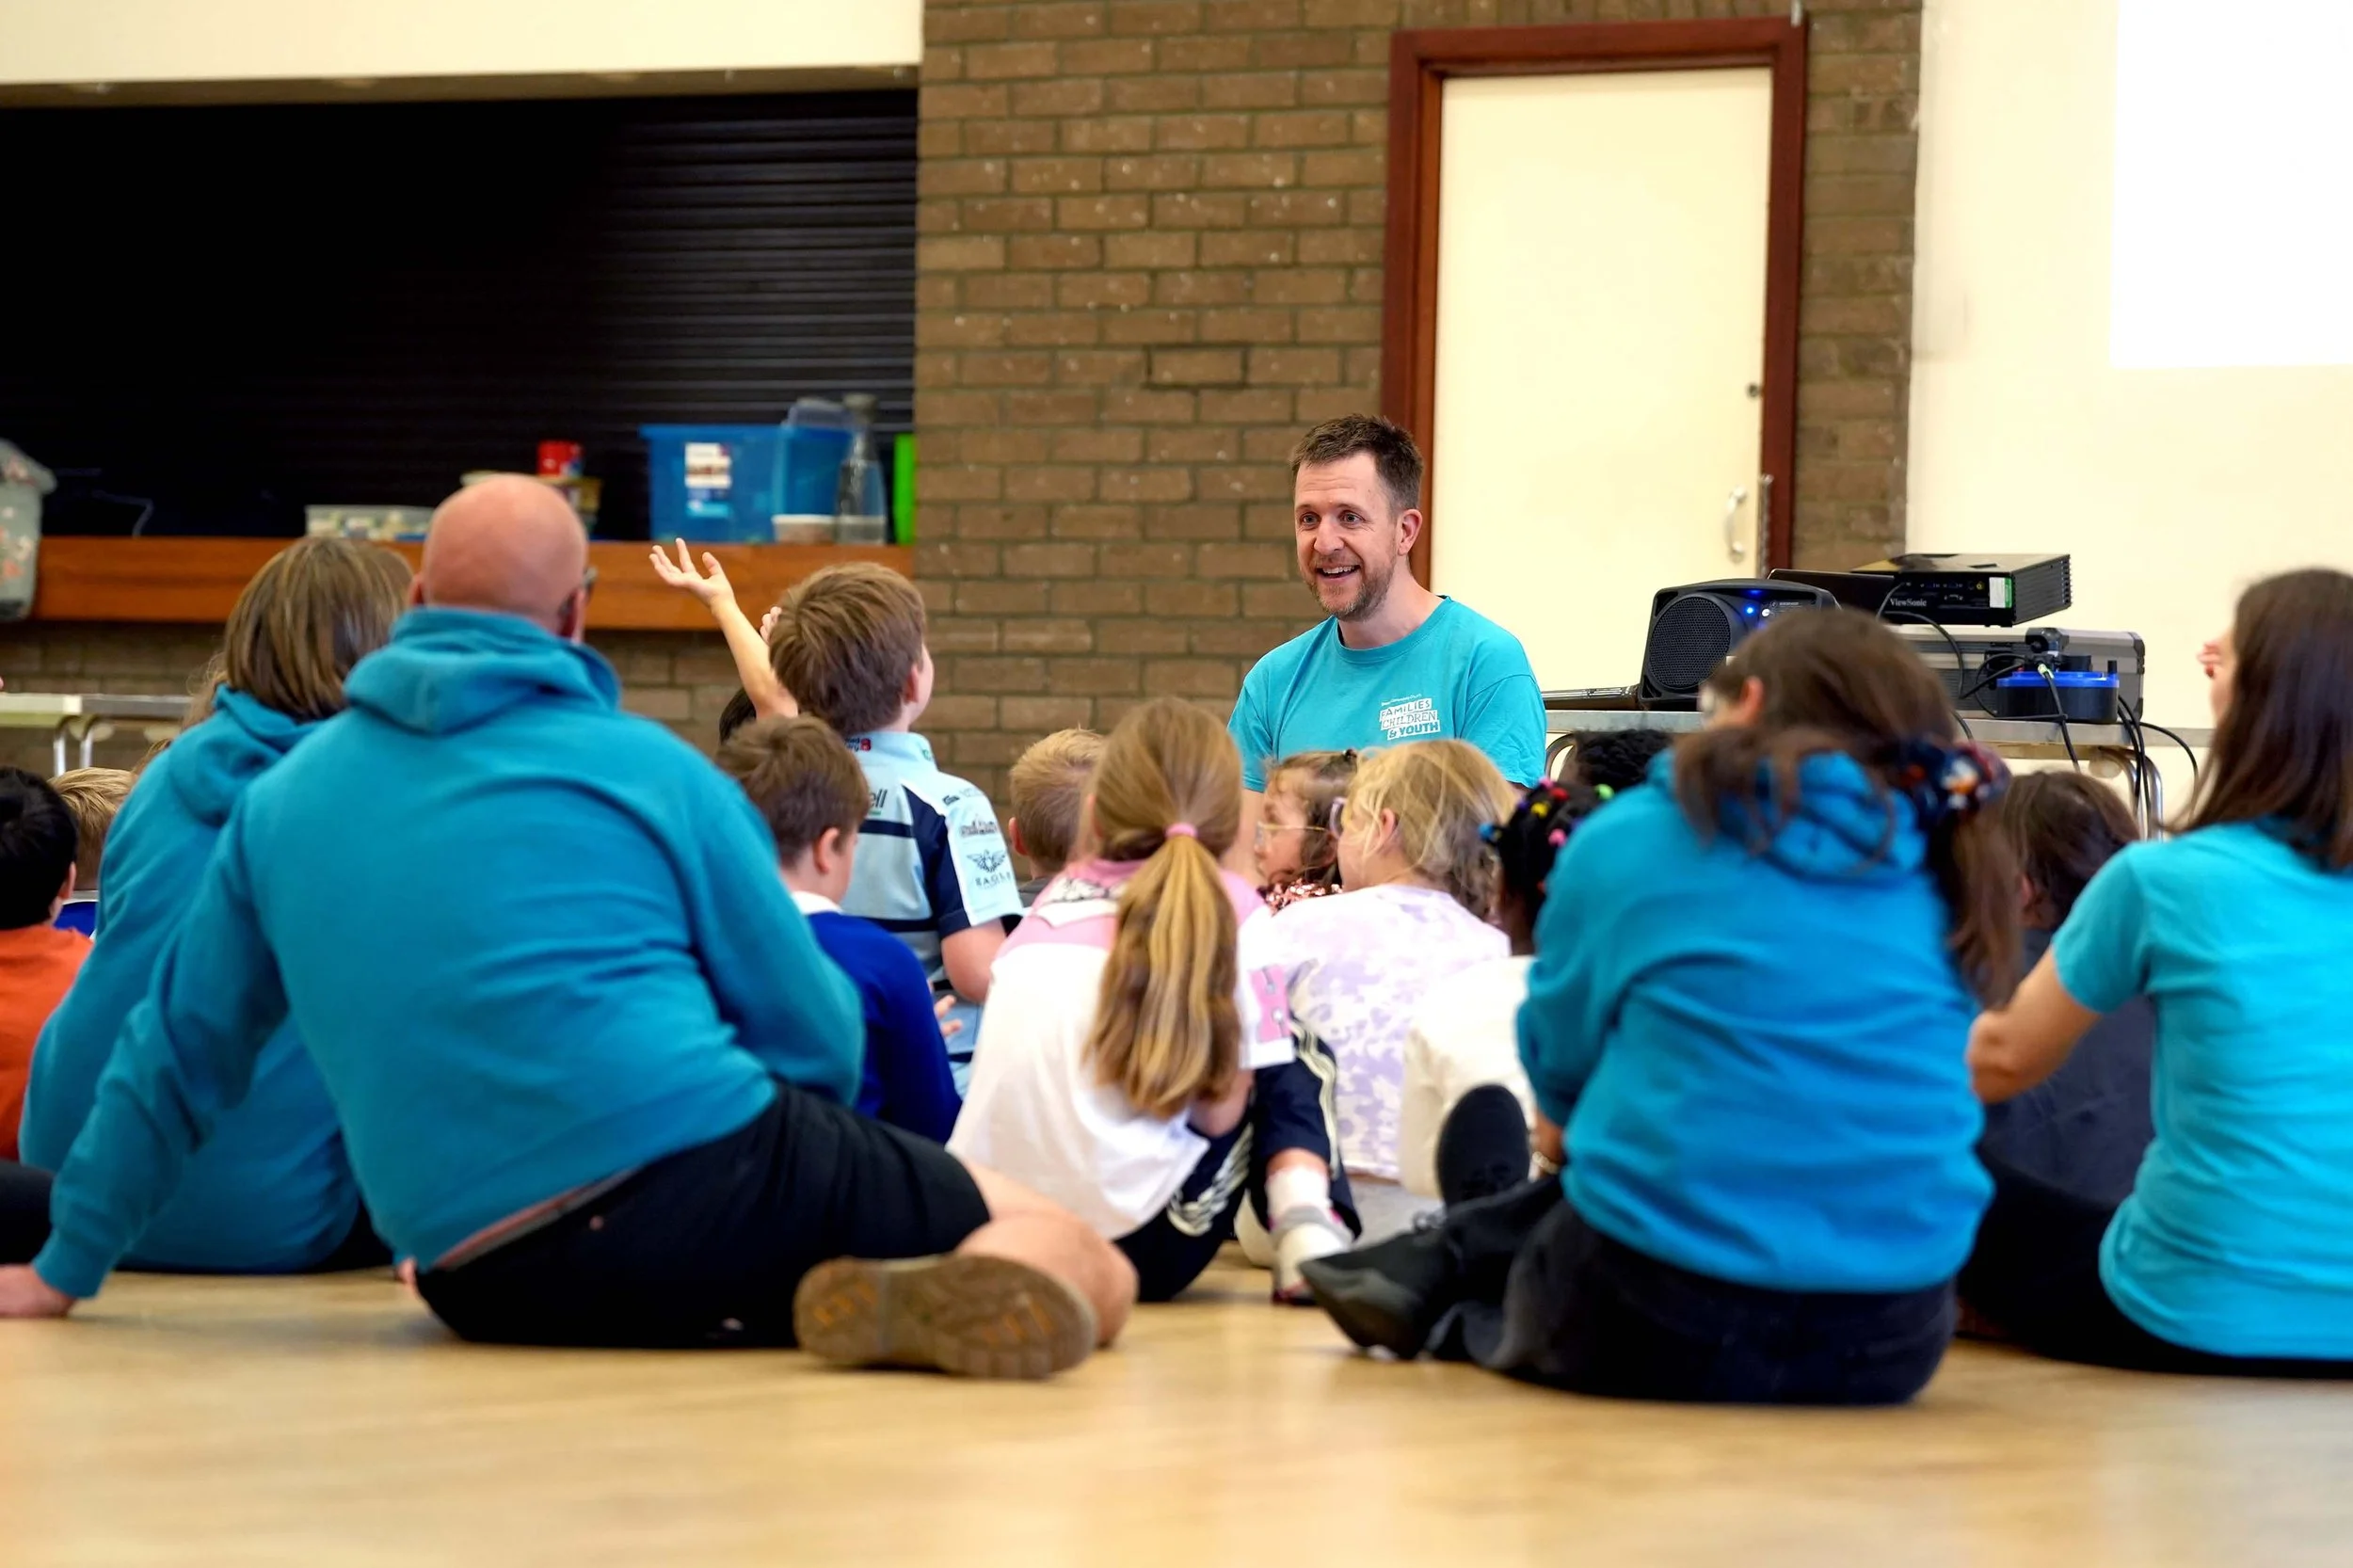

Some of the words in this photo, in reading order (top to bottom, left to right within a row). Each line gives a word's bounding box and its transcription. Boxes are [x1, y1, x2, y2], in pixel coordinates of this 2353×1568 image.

[1890, 598, 1928, 607] ViewSonic
[1382, 711, 1436, 728] CHILDREN
[1388, 729, 1398, 739] &
[1399, 721, 1439, 736] YOUTH
